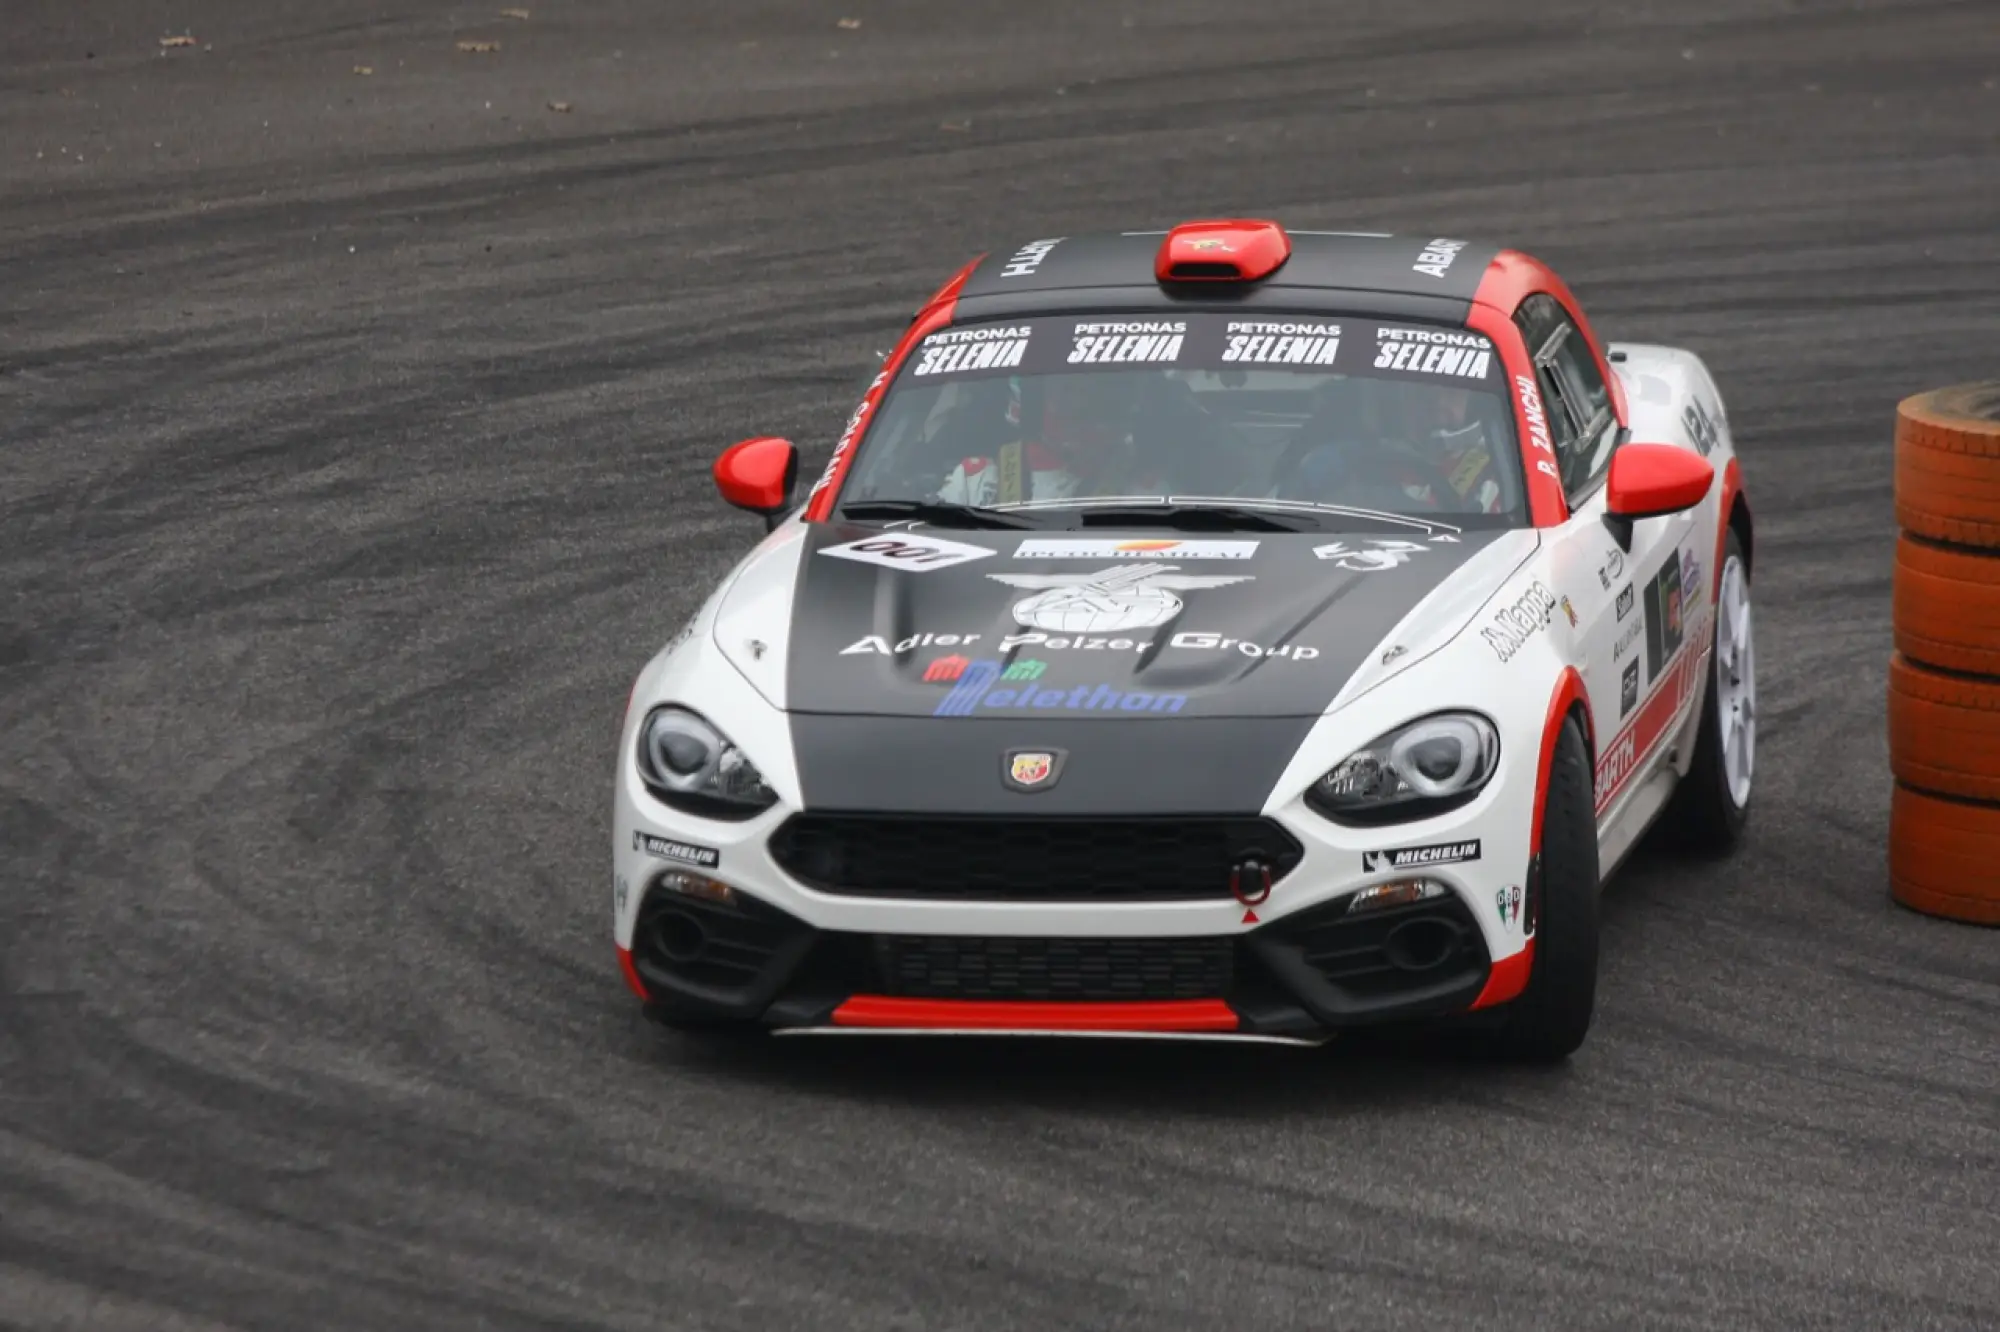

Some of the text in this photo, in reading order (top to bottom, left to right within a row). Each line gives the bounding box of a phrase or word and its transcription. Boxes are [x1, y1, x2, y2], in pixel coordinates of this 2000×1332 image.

[924, 326, 1032, 346] PETRONAS
[1075, 322, 1187, 335] PETRONAS
[1227, 322, 1341, 336] PETRONAS
[1377, 328, 1492, 349] PETRONAS
[914, 339, 1029, 376] SELENIA
[1067, 335, 1184, 364] SELENIA
[1222, 336, 1340, 365] SELENIA
[1373, 342, 1491, 379] SELENIA
[1515, 375, 1552, 454] ZANCHI
[1494, 580, 1557, 645] Kappa
[838, 631, 1320, 660] Adler Pelzer Group
[647, 839, 717, 863] MICHELIN
[1395, 842, 1477, 863] MICHELIN
